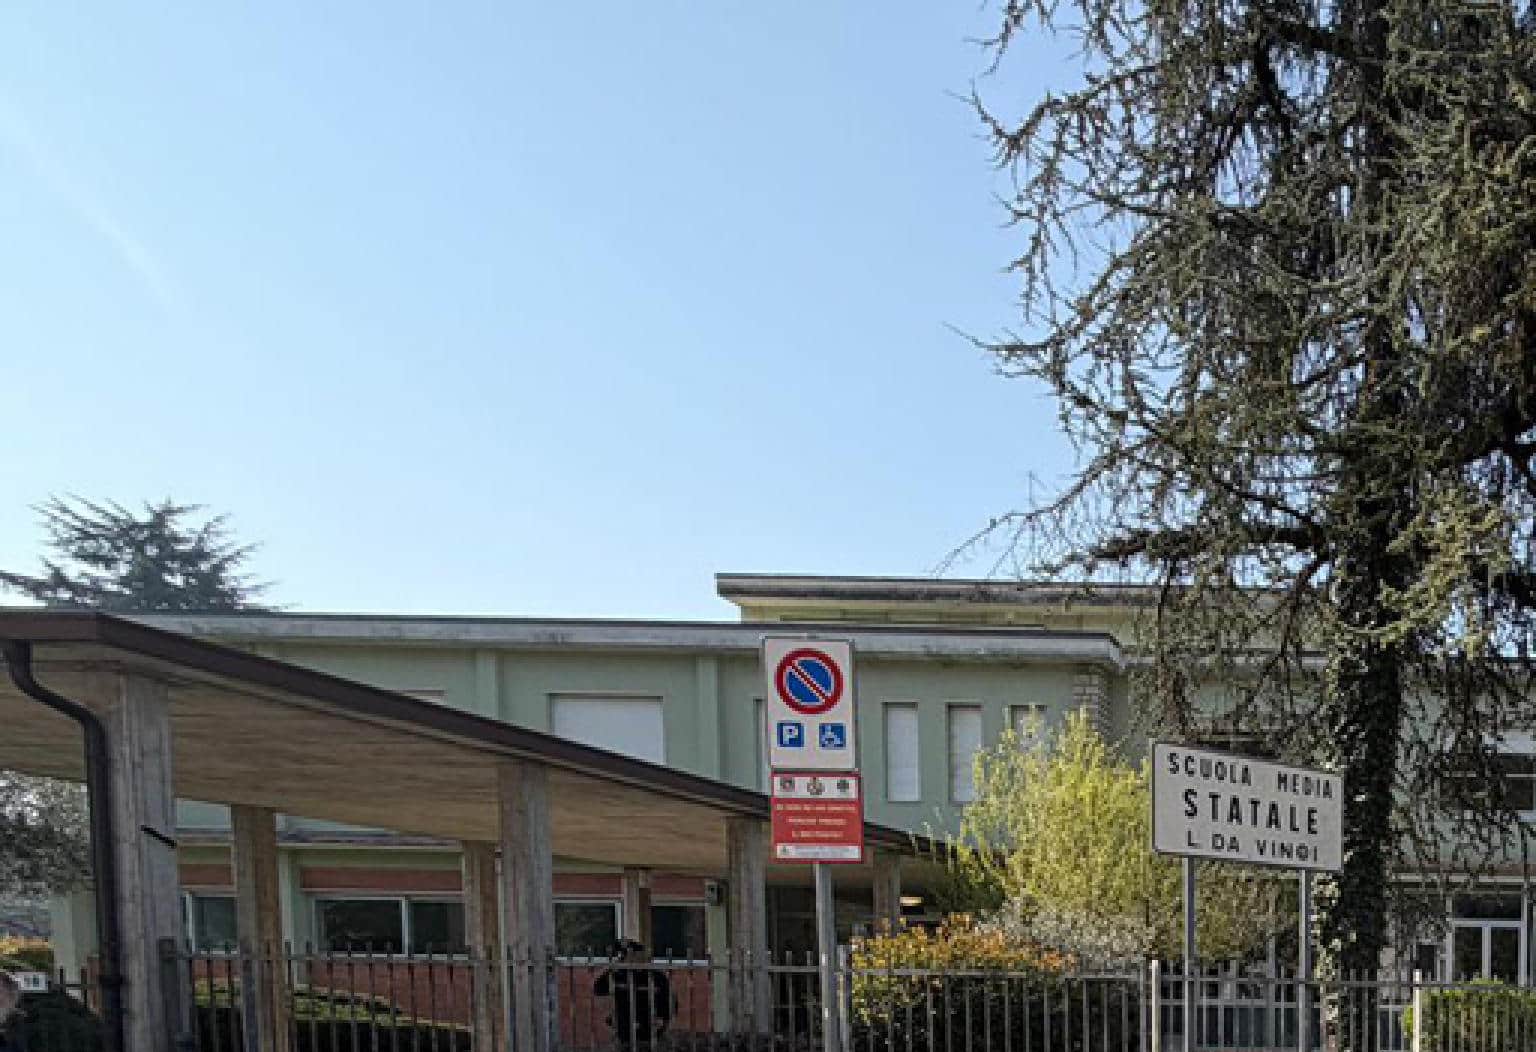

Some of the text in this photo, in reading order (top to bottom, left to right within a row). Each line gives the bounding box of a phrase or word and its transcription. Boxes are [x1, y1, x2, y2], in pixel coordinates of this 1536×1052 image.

[782, 725, 799, 744] P
[1167, 752, 1251, 786] SCUOLA
[1183, 788, 1318, 834] STATALE
[1211, 833, 1240, 853] DA
[1256, 839, 1319, 862] VINCI
